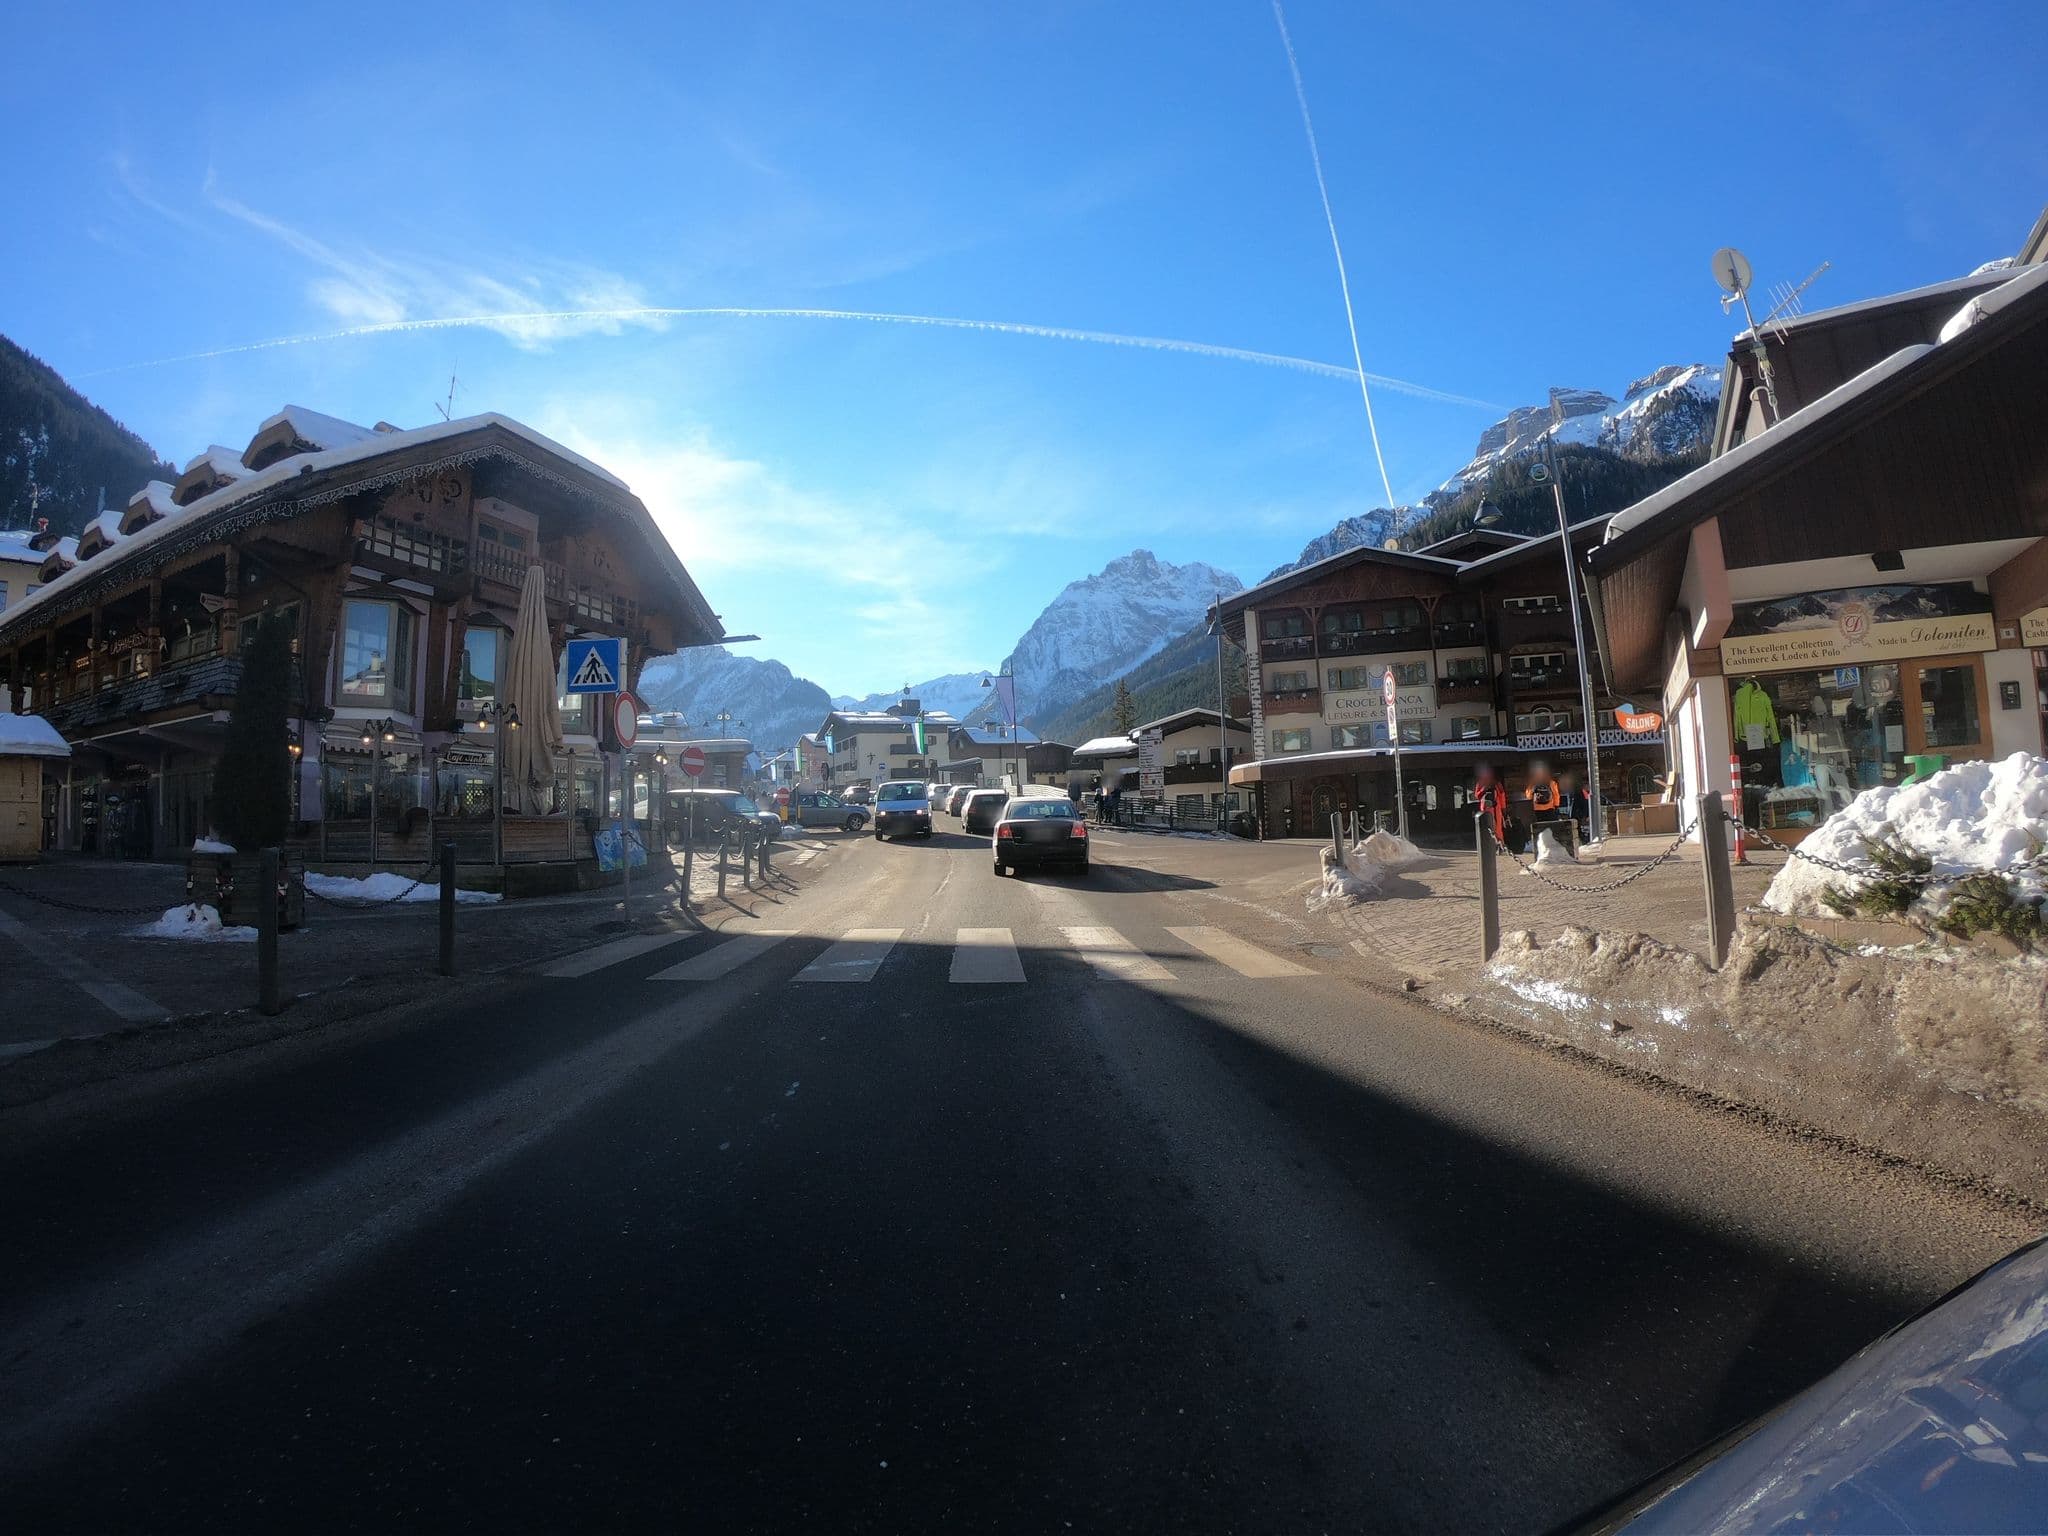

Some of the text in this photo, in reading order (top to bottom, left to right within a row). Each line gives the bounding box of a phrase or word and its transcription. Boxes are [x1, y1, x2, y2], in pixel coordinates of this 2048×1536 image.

[2028, 619, 2045, 628] The
[1878, 637, 1899, 646] Made
[1900, 636, 1908, 644] in
[1910, 624, 1987, 643] Dolomiten
[1731, 639, 1834, 656] The Excellent Collection
[1725, 648, 1841, 666] Cashmere & Loden & Polo
[1336, 697, 1377, 709] CROCE
[1328, 710, 1368, 721] LEISURE
[1370, 710, 1378, 718] &
[1400, 705, 1433, 715] HOTEL
[1626, 715, 1656, 729] SALONE
